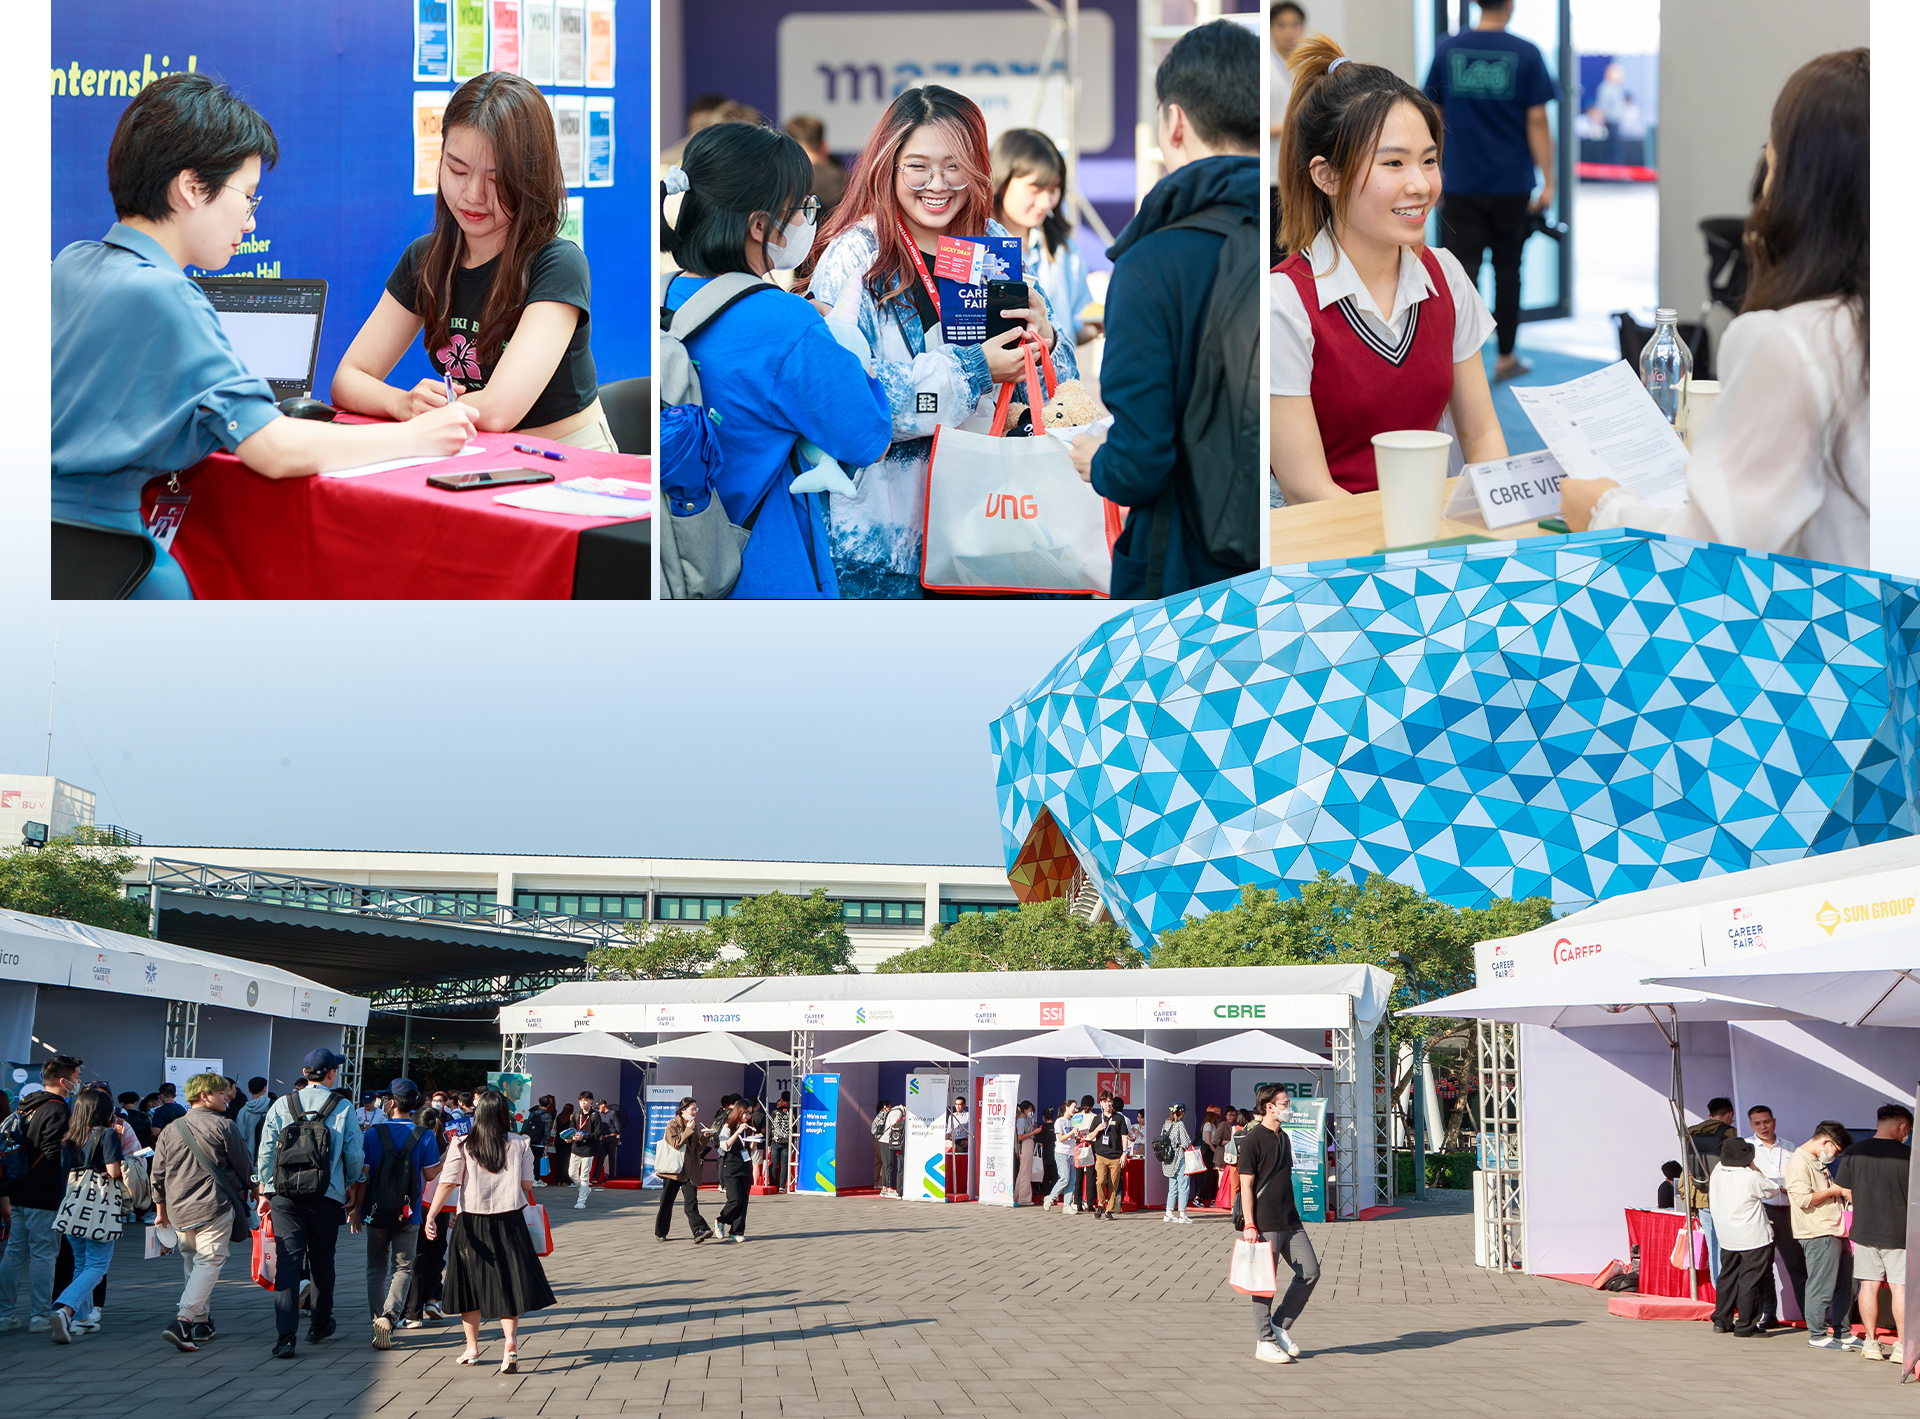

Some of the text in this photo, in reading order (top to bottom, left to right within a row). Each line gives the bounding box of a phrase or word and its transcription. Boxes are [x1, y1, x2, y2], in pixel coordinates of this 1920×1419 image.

[1489, 482, 1535, 506] CBRE
[1842, 896, 1916, 924] SUN GROUP
[1728, 924, 1764, 939] CAREER
[1733, 937, 1754, 949] FAIR
[92, 966, 111, 975] CAREER
[1491, 959, 1515, 971] CAREER
[94, 974, 105, 982] FAIR
[1495, 969, 1509, 979] FAIR
[328, 1005, 338, 1018] EY
[1042, 1007, 1062, 1020] SSI
[1214, 1004, 1266, 1019] CBRE
[573, 1019, 590, 1028] pwc
[702, 1014, 741, 1022] mazars
[987, 1103, 1007, 1116] TOP 1
